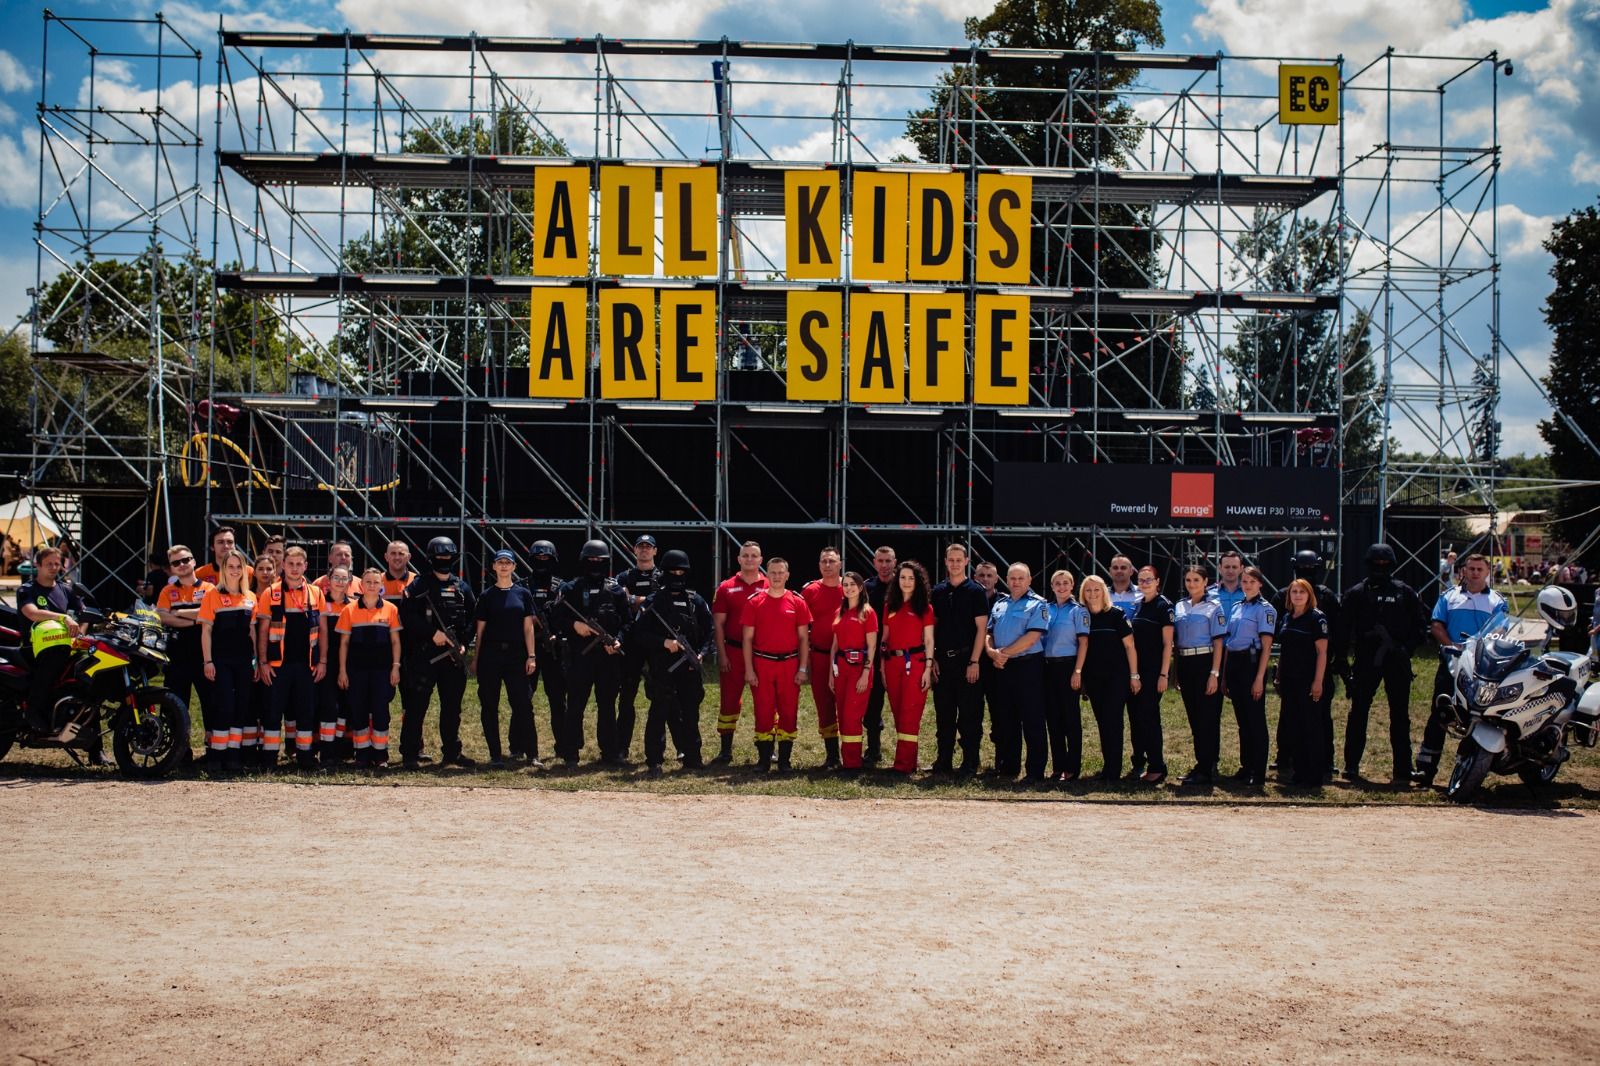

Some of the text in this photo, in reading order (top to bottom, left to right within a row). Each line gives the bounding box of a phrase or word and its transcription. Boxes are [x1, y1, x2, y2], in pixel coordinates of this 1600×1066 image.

[1289, 75, 1330, 113] EC
[542, 179, 1022, 270] ALL KIDS
[538, 300, 1018, 390] ARE SAFE
[1110, 503, 1159, 516] Powered by
[1172, 505, 1210, 517] orange
[1226, 506, 1267, 516] HUAWEI
[1269, 506, 1285, 516] P30
[1290, 507, 1305, 516] P30
[1307, 507, 1321, 517] Pro
